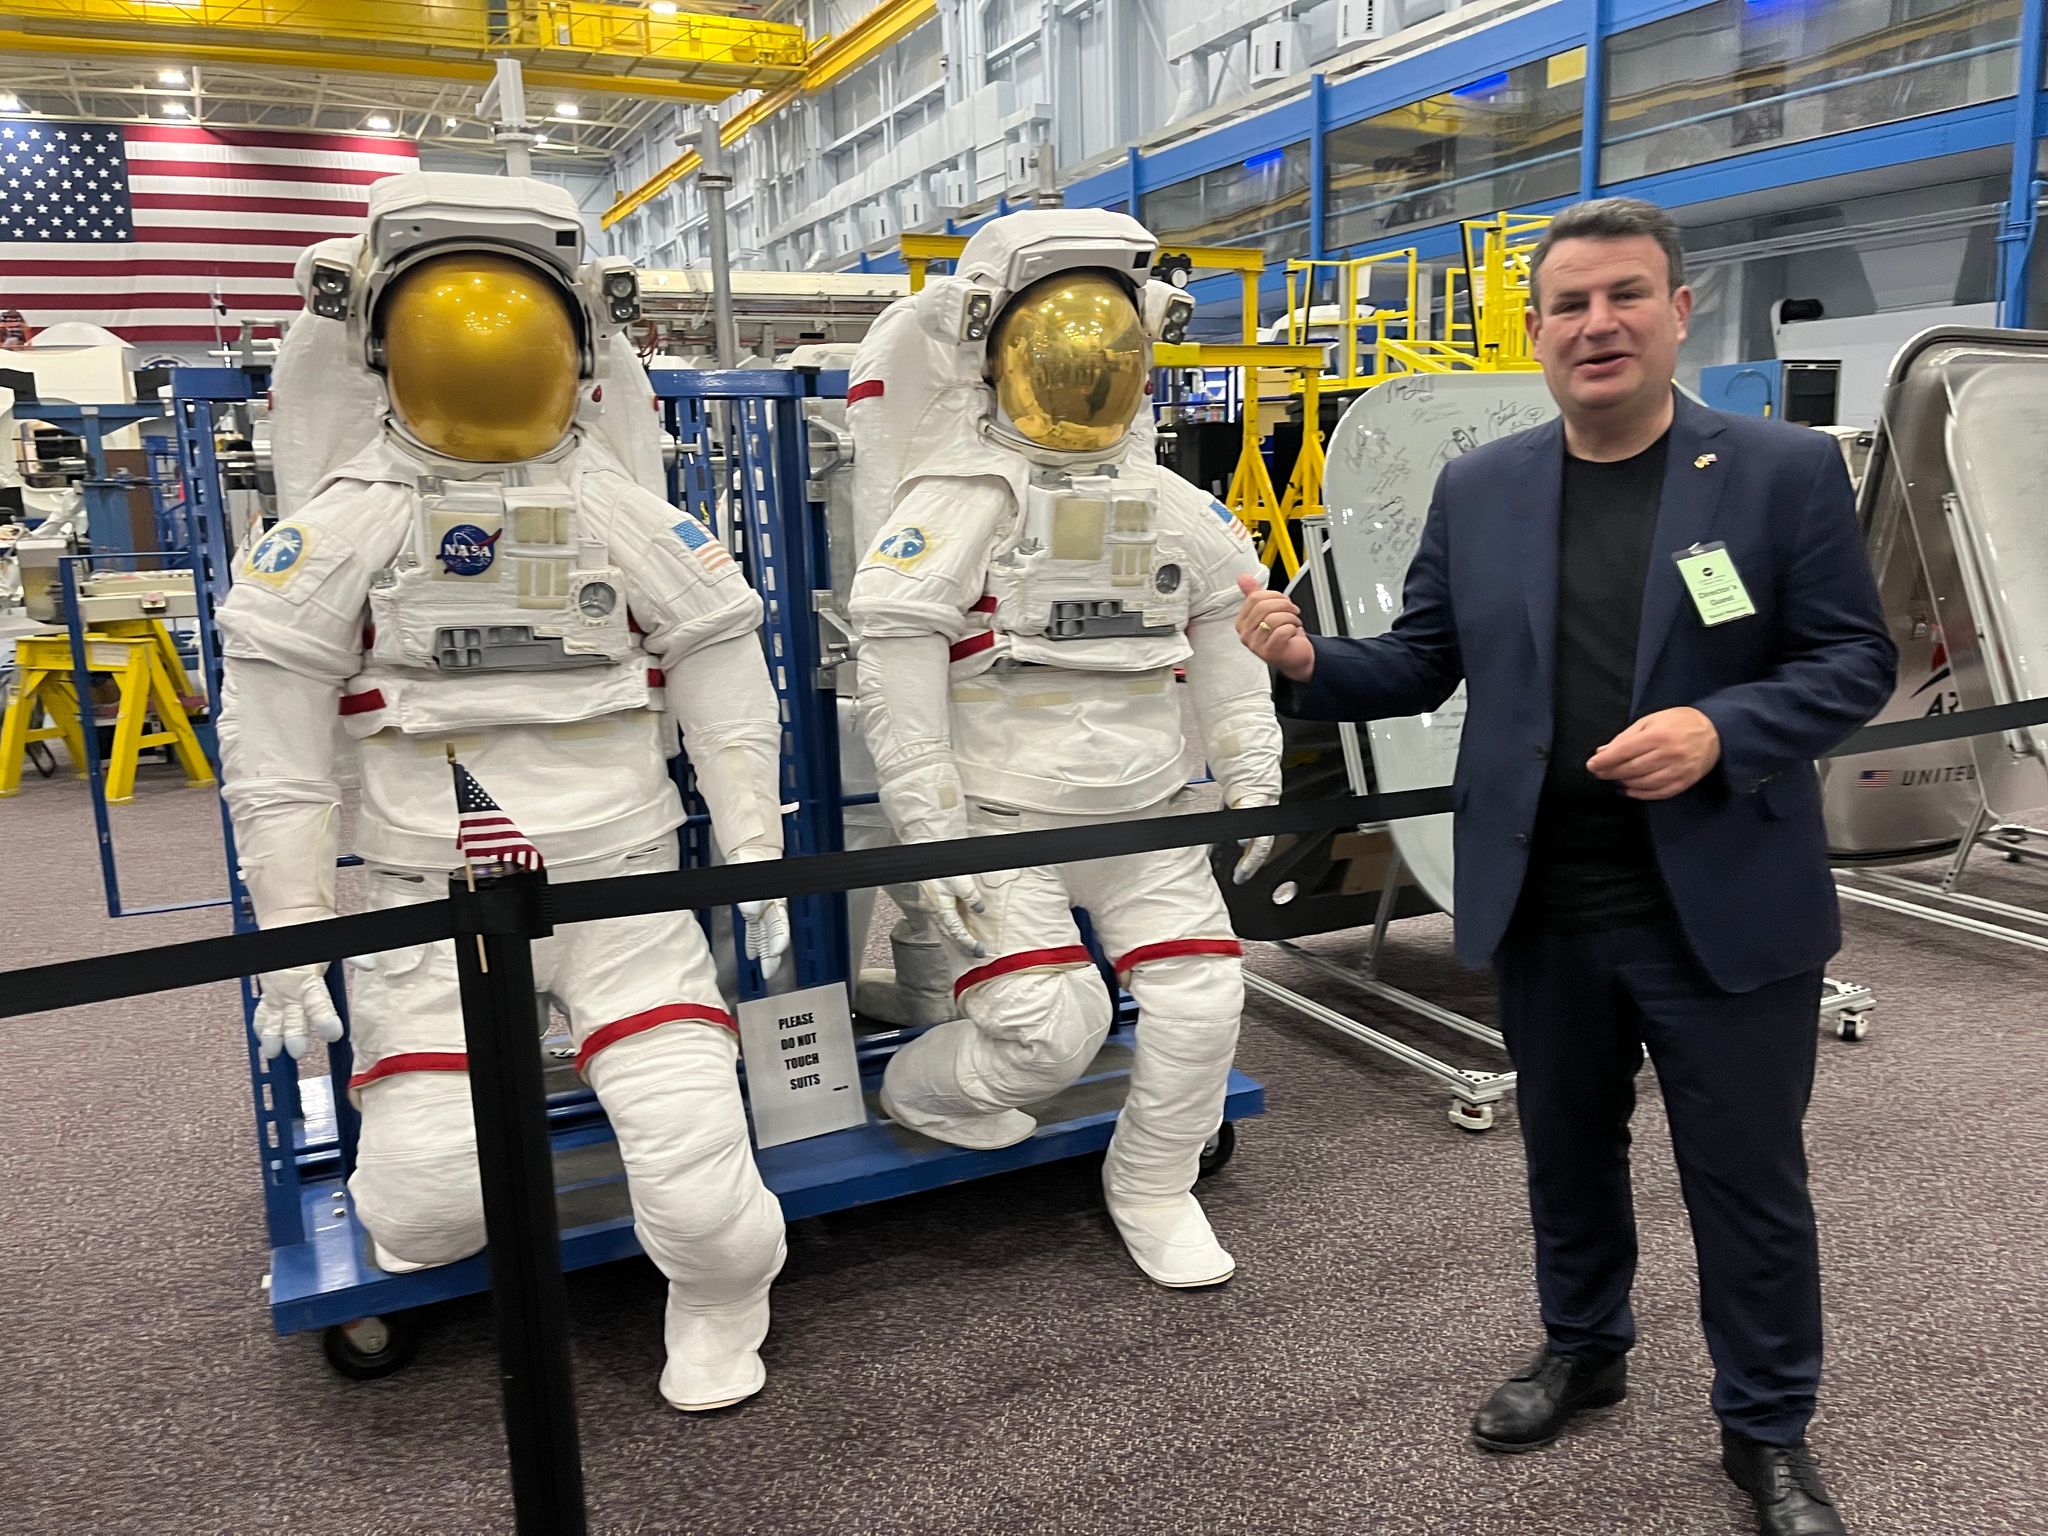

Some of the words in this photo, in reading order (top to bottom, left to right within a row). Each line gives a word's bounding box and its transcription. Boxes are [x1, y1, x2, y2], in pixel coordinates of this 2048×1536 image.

[444, 543, 492, 557] NASA
[778, 1012, 815, 1030] PLEASE
[780, 1037, 796, 1051] DO
[797, 1032, 817, 1047] NOT
[784, 1053, 820, 1070] TOUCH
[790, 1073, 821, 1090] SUITS
